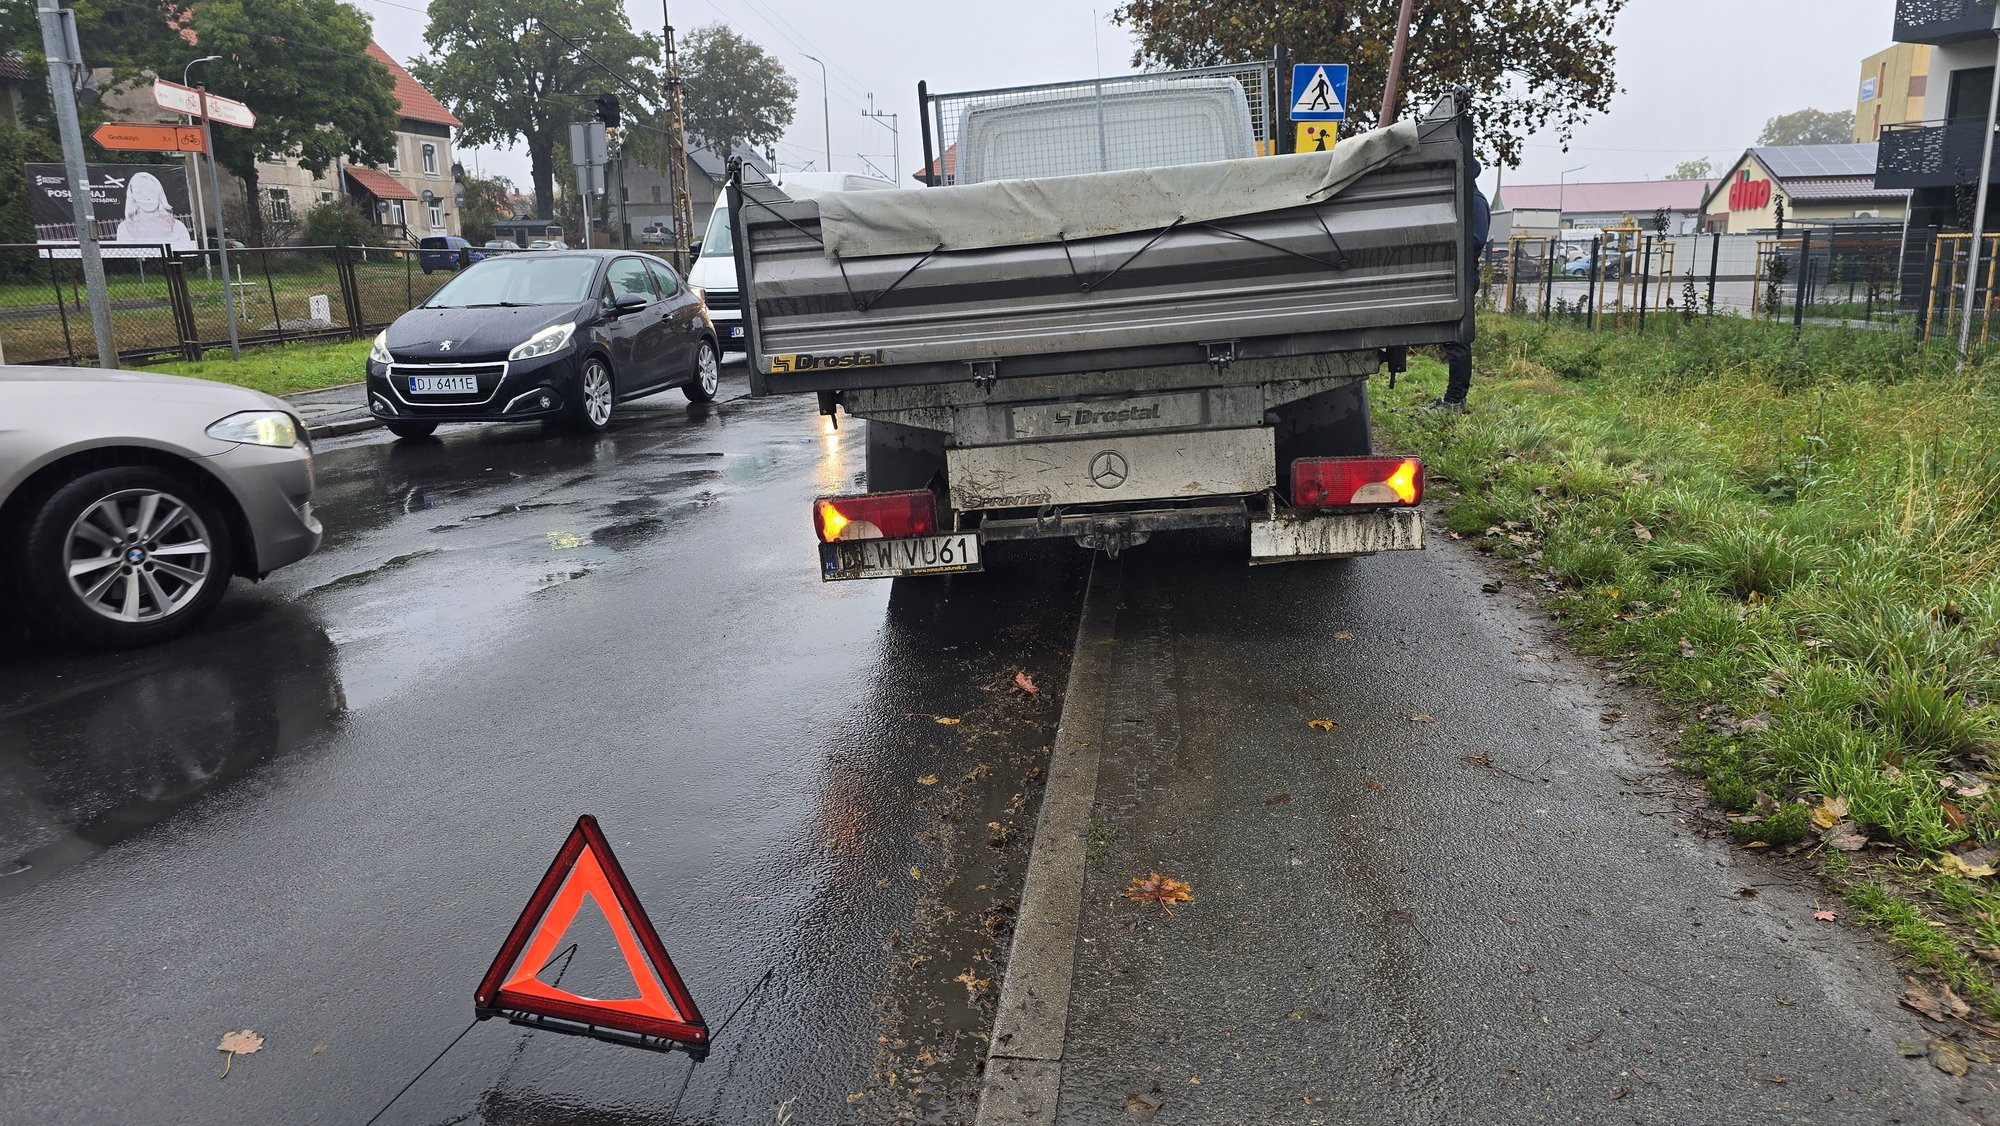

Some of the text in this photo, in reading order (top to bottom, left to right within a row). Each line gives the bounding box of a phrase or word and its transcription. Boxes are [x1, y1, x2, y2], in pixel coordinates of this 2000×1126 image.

[1729, 169, 1771, 211] dino
[795, 349, 885, 370] Drostal
[417, 377, 473, 390] DJ 6411E
[1075, 404, 1160, 425] Drostal
[902, 537, 968, 566] VU61
